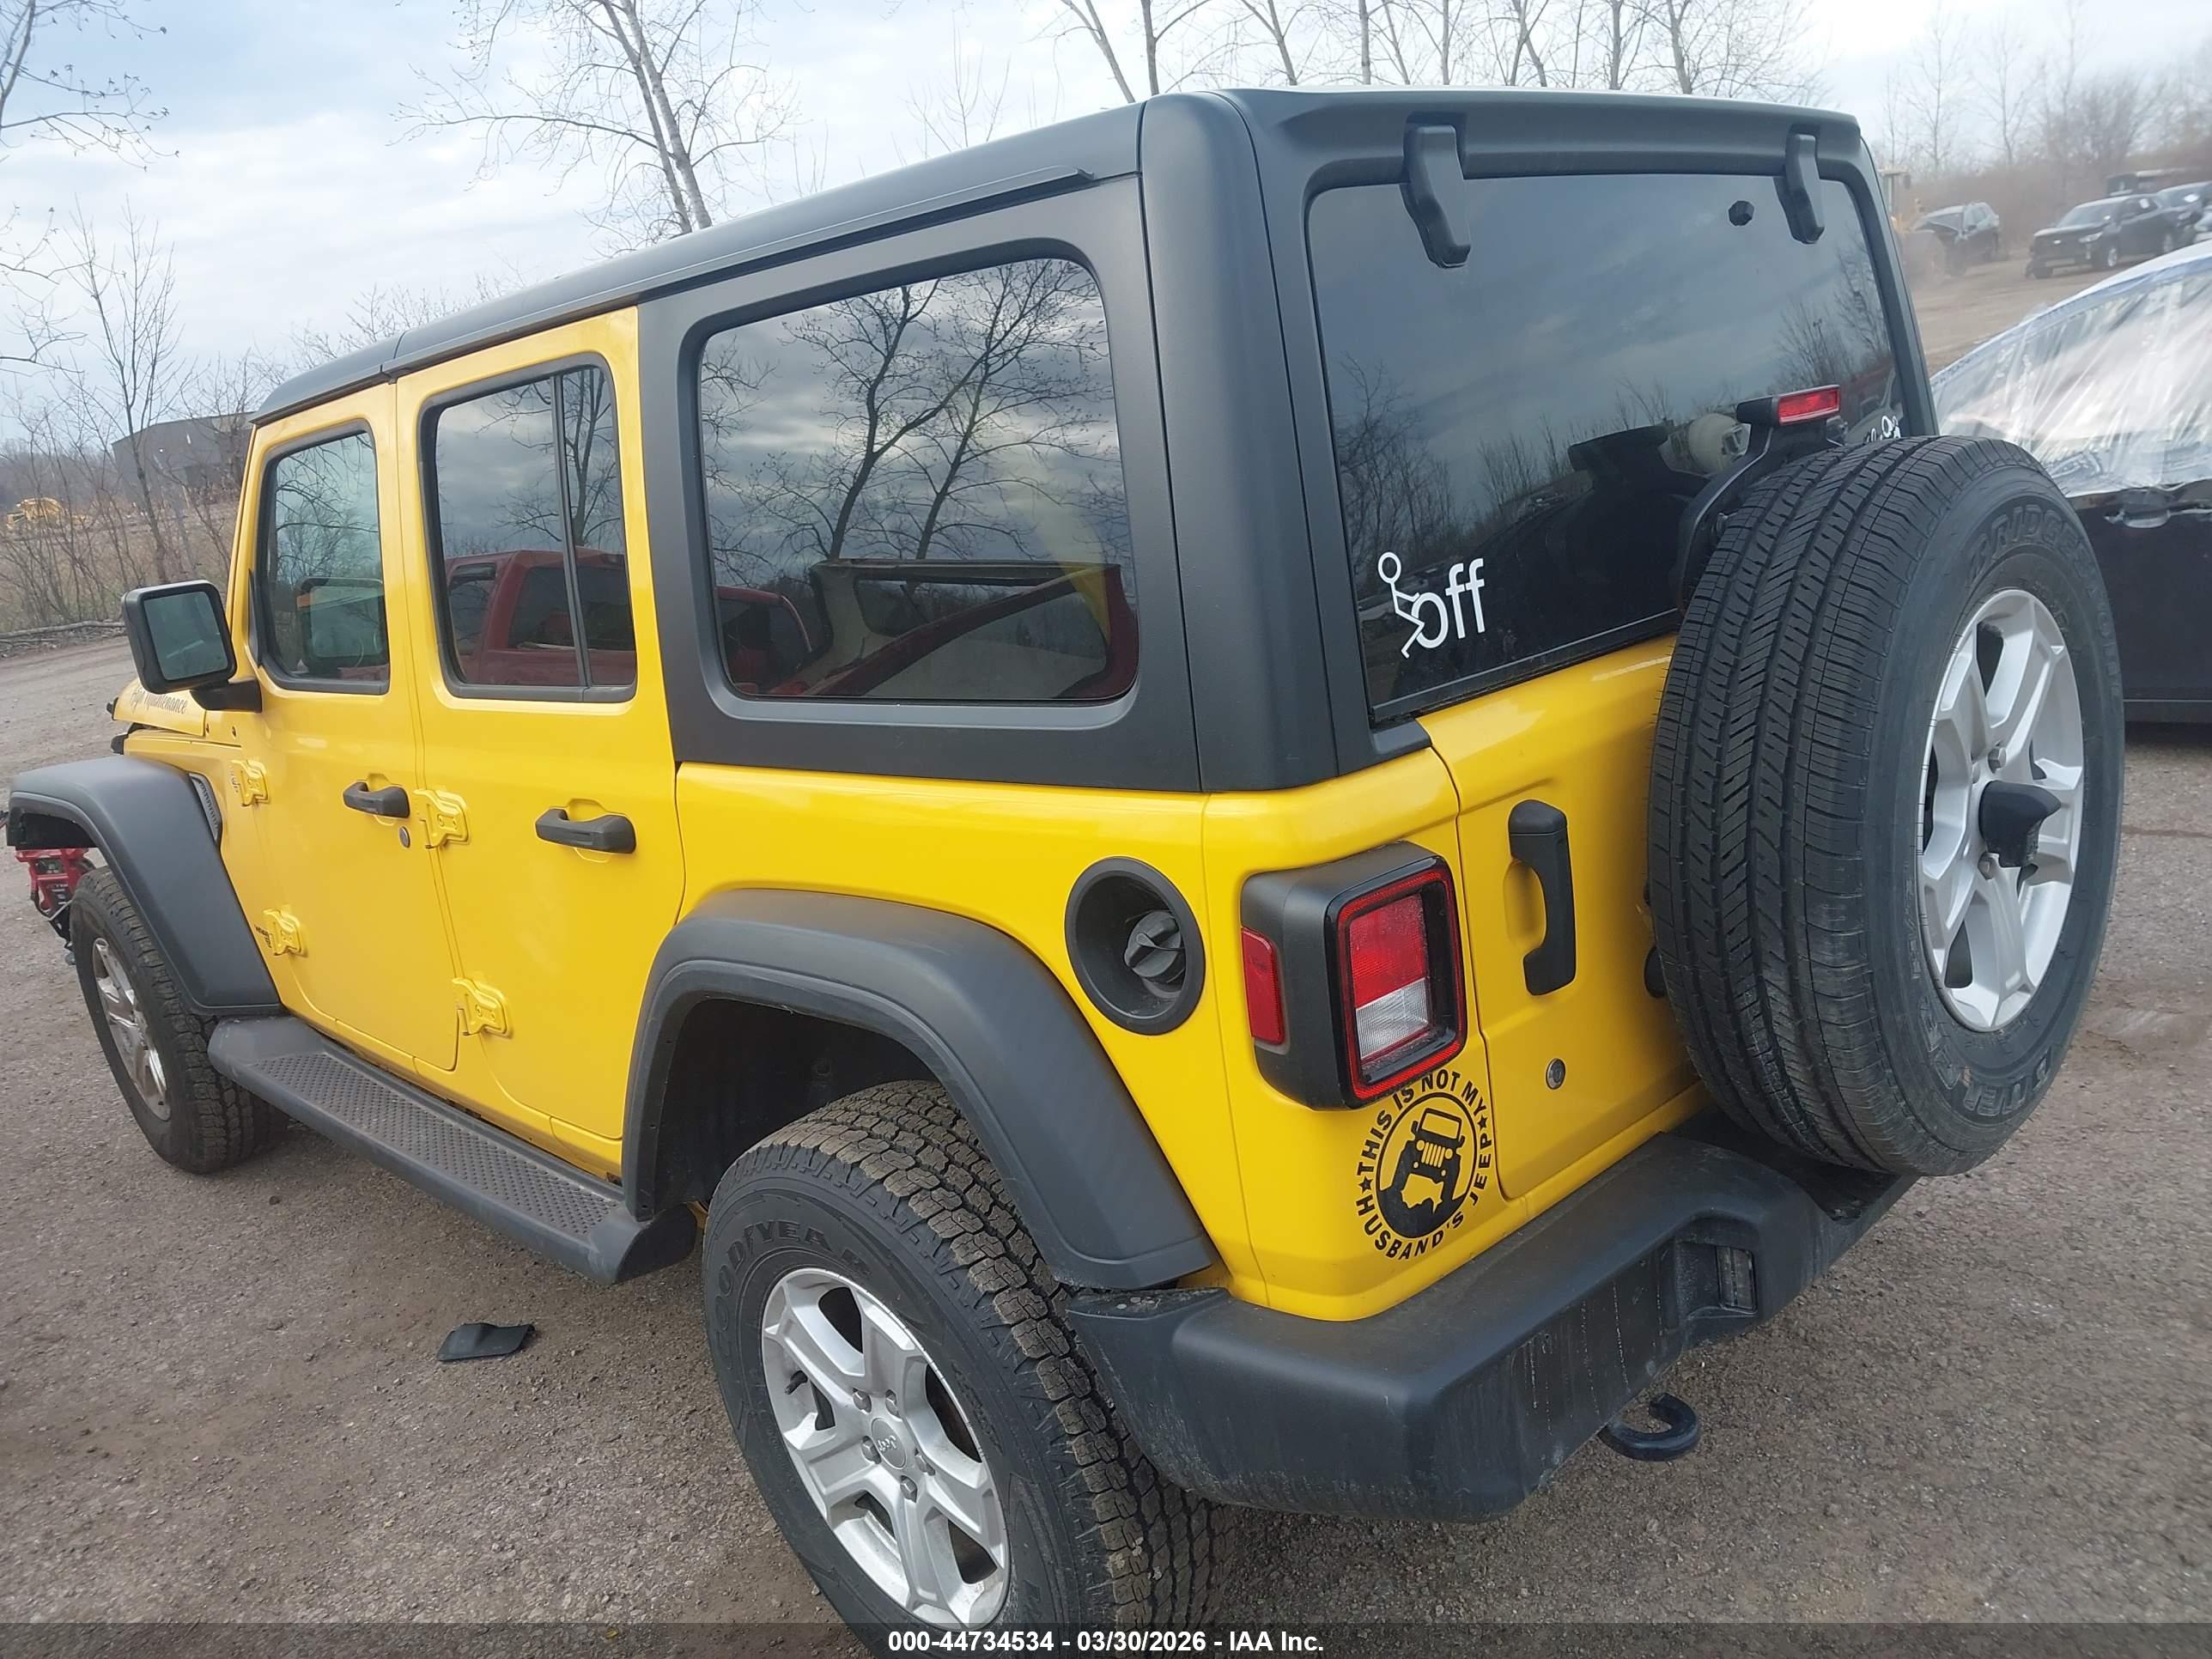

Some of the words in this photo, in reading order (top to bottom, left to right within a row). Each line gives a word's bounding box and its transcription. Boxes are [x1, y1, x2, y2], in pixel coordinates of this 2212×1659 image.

[1411, 557, 1486, 649] off
[1357, 1109, 1392, 1176] THIS
[1392, 1087, 1414, 1110] IS
[1421, 1069, 1461, 1092] NOT
[1462, 1080, 1488, 1115] MY
[1356, 1194, 1464, 1261] HUSBAND'S
[1469, 1133, 1493, 1206] JEEP
